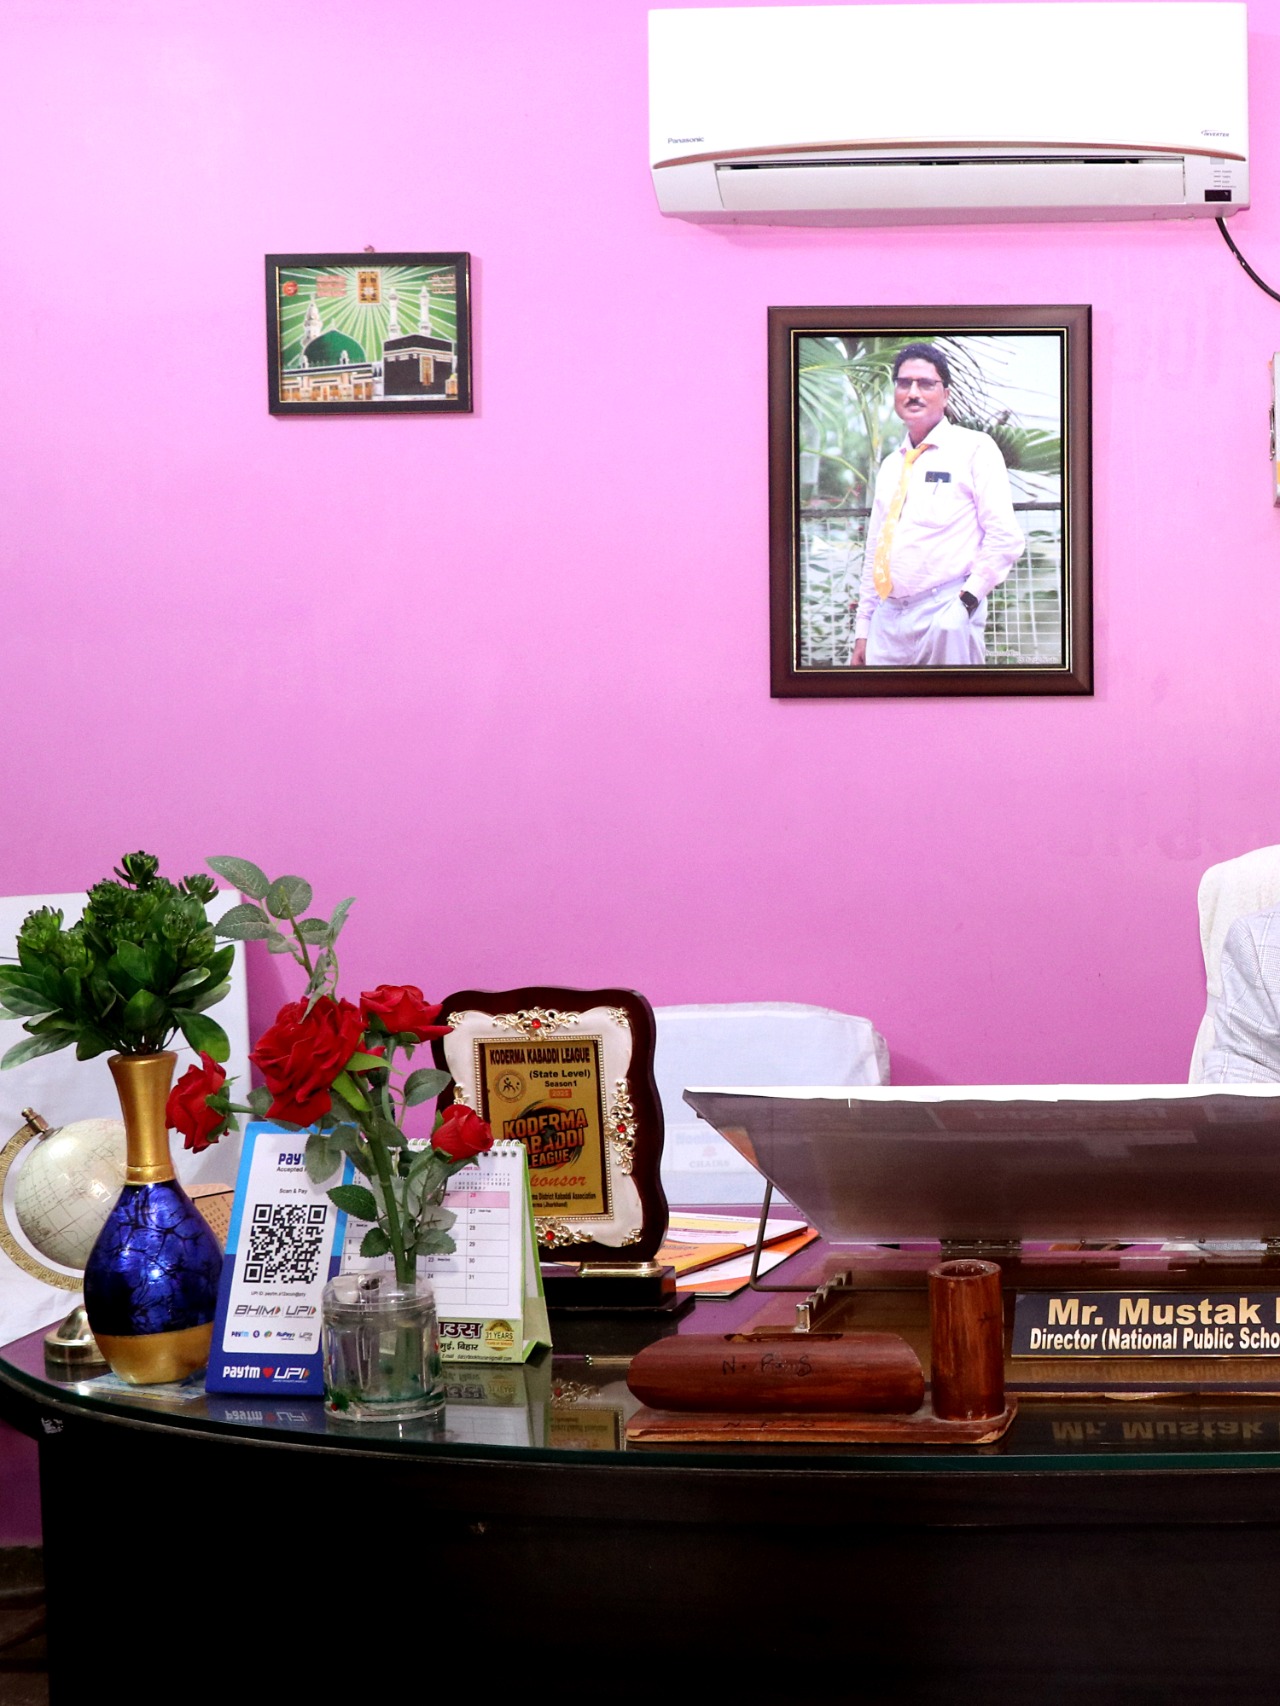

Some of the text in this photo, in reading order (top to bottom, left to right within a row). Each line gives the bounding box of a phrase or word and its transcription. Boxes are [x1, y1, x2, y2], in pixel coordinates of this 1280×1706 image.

[489, 1047, 591, 1065] KODERMA KABADDI LEAGUE
[529, 1069, 591, 1080] (State Level)
[503, 1108, 588, 1140] KODERMA
[520, 1128, 585, 1153] ABADDI
[530, 1174, 587, 1187] ponsor
[234, 1304, 277, 1316] BHIM
[1048, 1298, 1104, 1325] Mr.
[1118, 1297, 1262, 1325] Mustak
[457, 1341, 478, 1351] बिहार
[1030, 1328, 1098, 1350] Director
[1101, 1327, 1178, 1350] (National
[1182, 1327, 1234, 1350] Public
[274, 1367, 305, 1379] UPI
